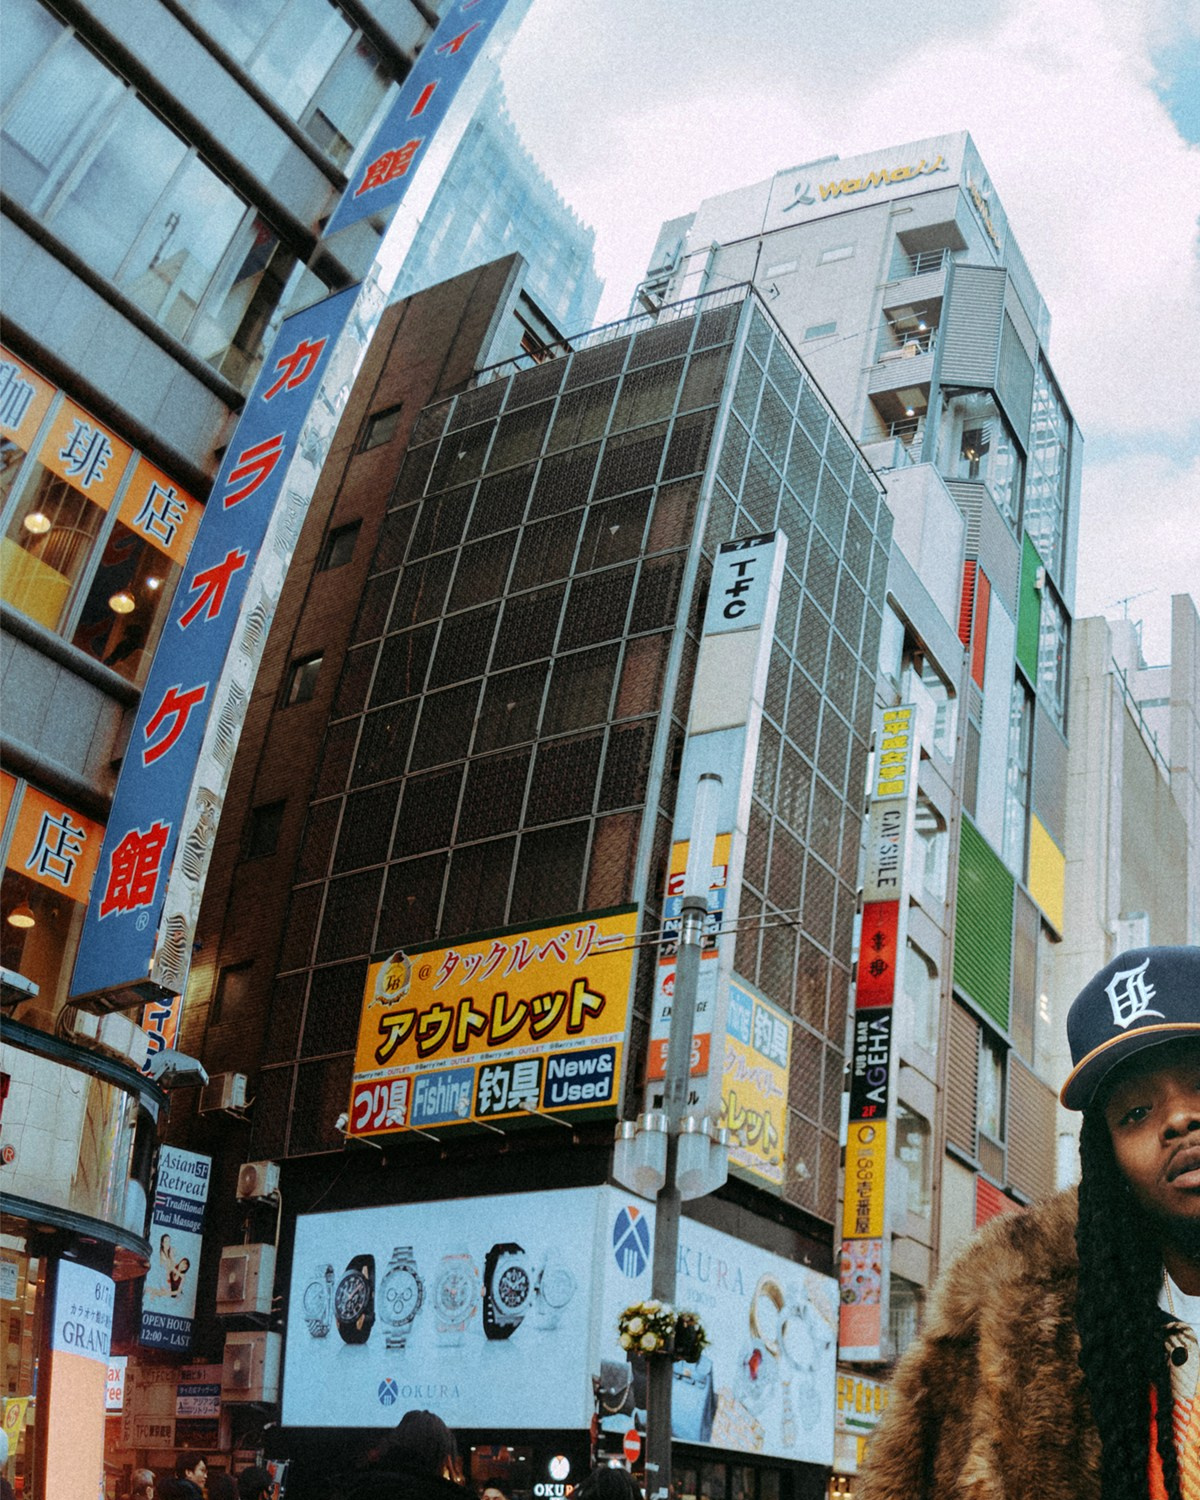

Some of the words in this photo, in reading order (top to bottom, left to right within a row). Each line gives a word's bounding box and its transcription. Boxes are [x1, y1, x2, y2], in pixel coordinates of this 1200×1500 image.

[98, 334, 328, 922] カラオケ館
[432, 922, 625, 991] タックルベリー
[374, 976, 607, 1066] アウトレット
[856, 1021, 869, 1043] BAR
[547, 1053, 614, 1080] New&
[855, 1057, 868, 1077] PUB
[866, 1015, 890, 1103] AGEHA
[413, 1076, 472, 1119] Fishing
[478, 1060, 542, 1113] 釣具
[551, 1077, 610, 1103] Used
[354, 1078, 409, 1130] つり具
[862, 1105, 877, 1118] 2F
[161, 1152, 196, 1175] Asian
[159, 1170, 206, 1197] Retreat
[165, 1197, 205, 1216] Traditional
[155, 1210, 172, 1224] Thai
[172, 1213, 201, 1231] Massage
[677, 1245, 745, 1297] KURA
[142, 1313, 165, 1330] OPEN
[166, 1318, 191, 1333] HOUR
[141, 1329, 162, 1342] 12:00
[170, 1335, 191, 1347] LAST
[401, 1383, 460, 1399] OKURA
[534, 1483, 574, 1498] OKUR
